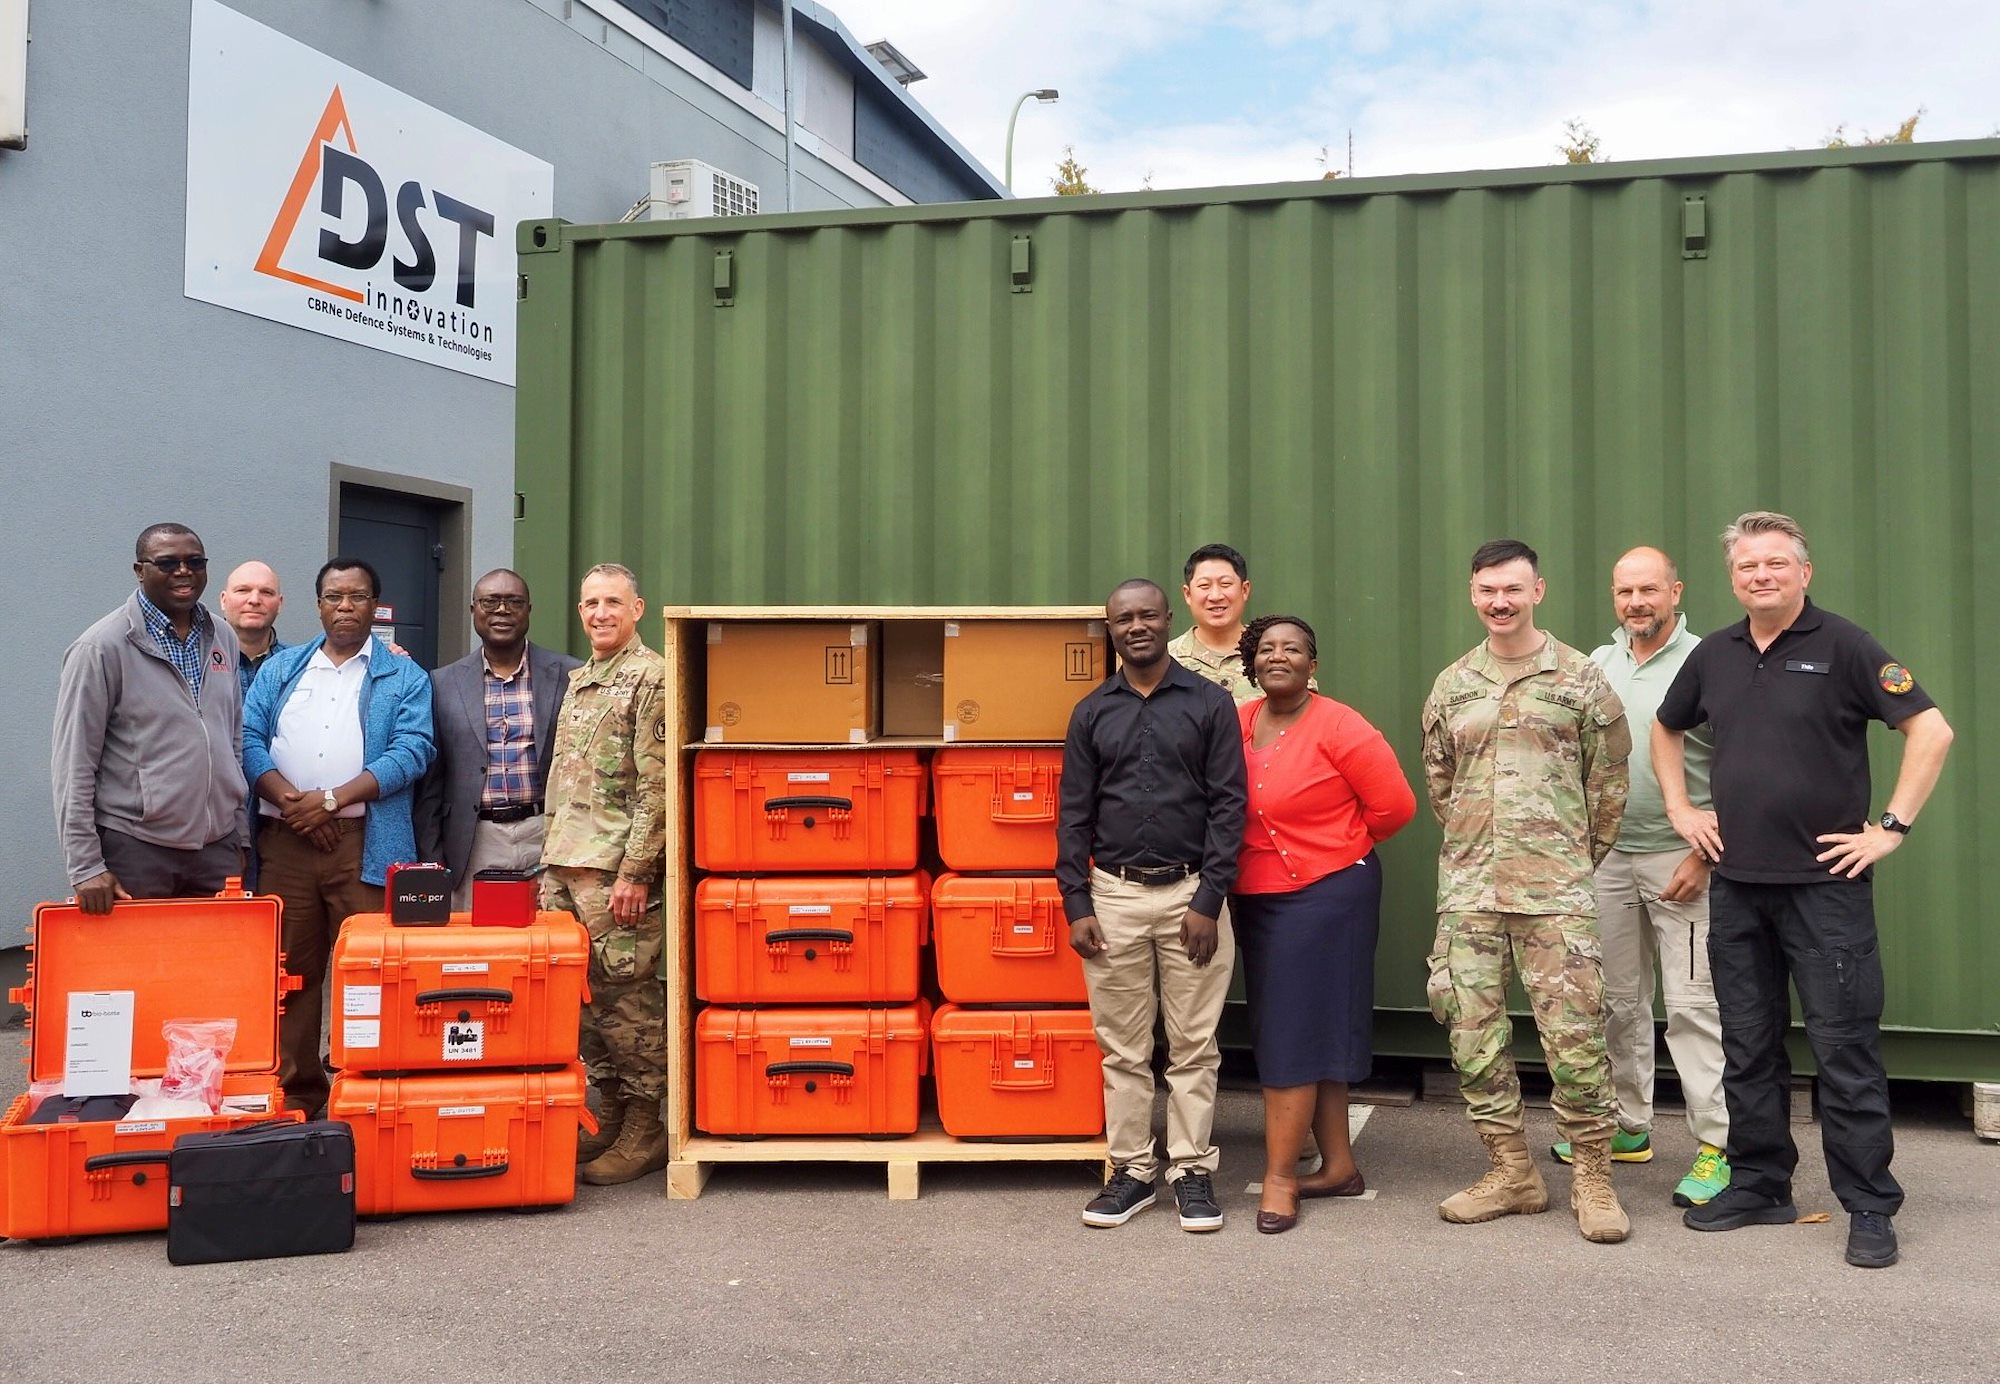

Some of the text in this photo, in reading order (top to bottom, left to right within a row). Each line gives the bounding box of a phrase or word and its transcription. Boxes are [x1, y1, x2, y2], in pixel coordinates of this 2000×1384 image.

[318, 144, 495, 309] DST
[307, 297, 492, 362] CBRNe Defence Systems & Technologies
[1450, 690, 1479, 703] SAINDON
[1557, 694, 1577, 706] ARMY
[399, 893, 444, 904] mic pcr
